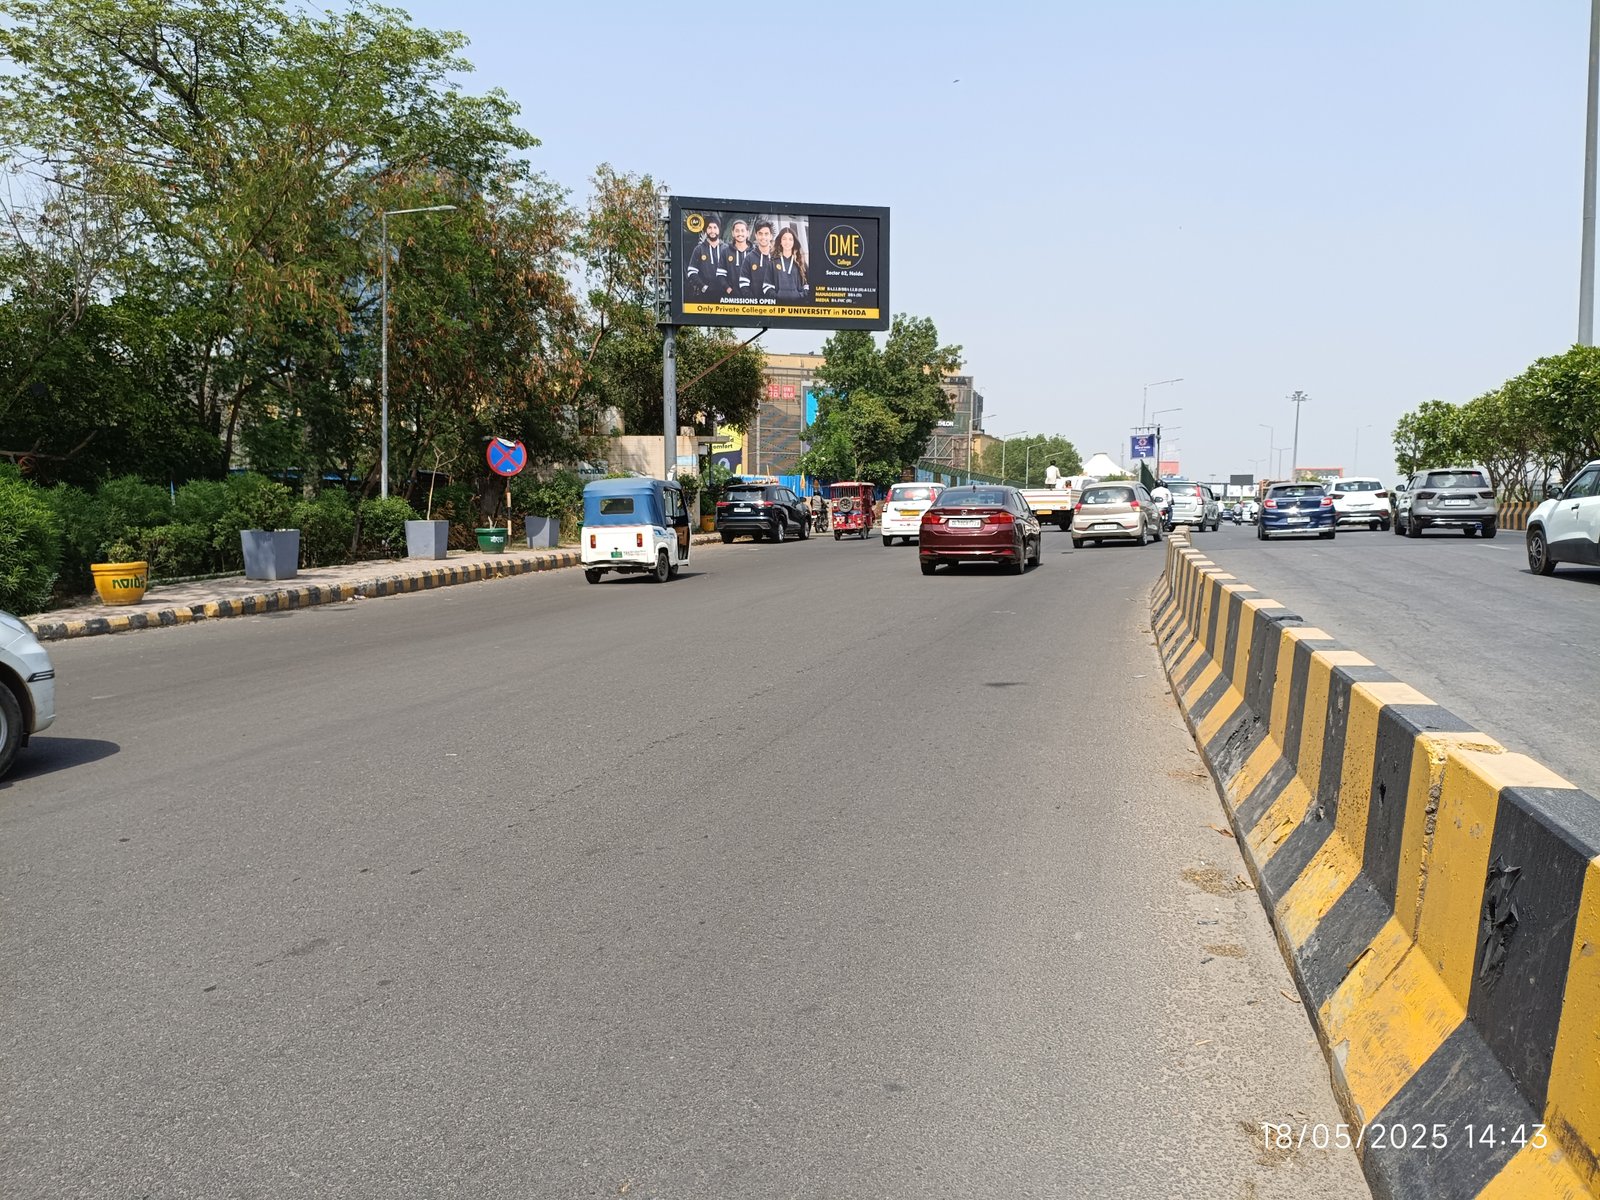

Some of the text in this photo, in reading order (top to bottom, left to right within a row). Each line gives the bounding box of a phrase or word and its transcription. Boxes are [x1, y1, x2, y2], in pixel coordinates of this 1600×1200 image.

[829, 234, 859, 256] DME
[697, 305, 713, 313] Only
[741, 306, 767, 314] College
